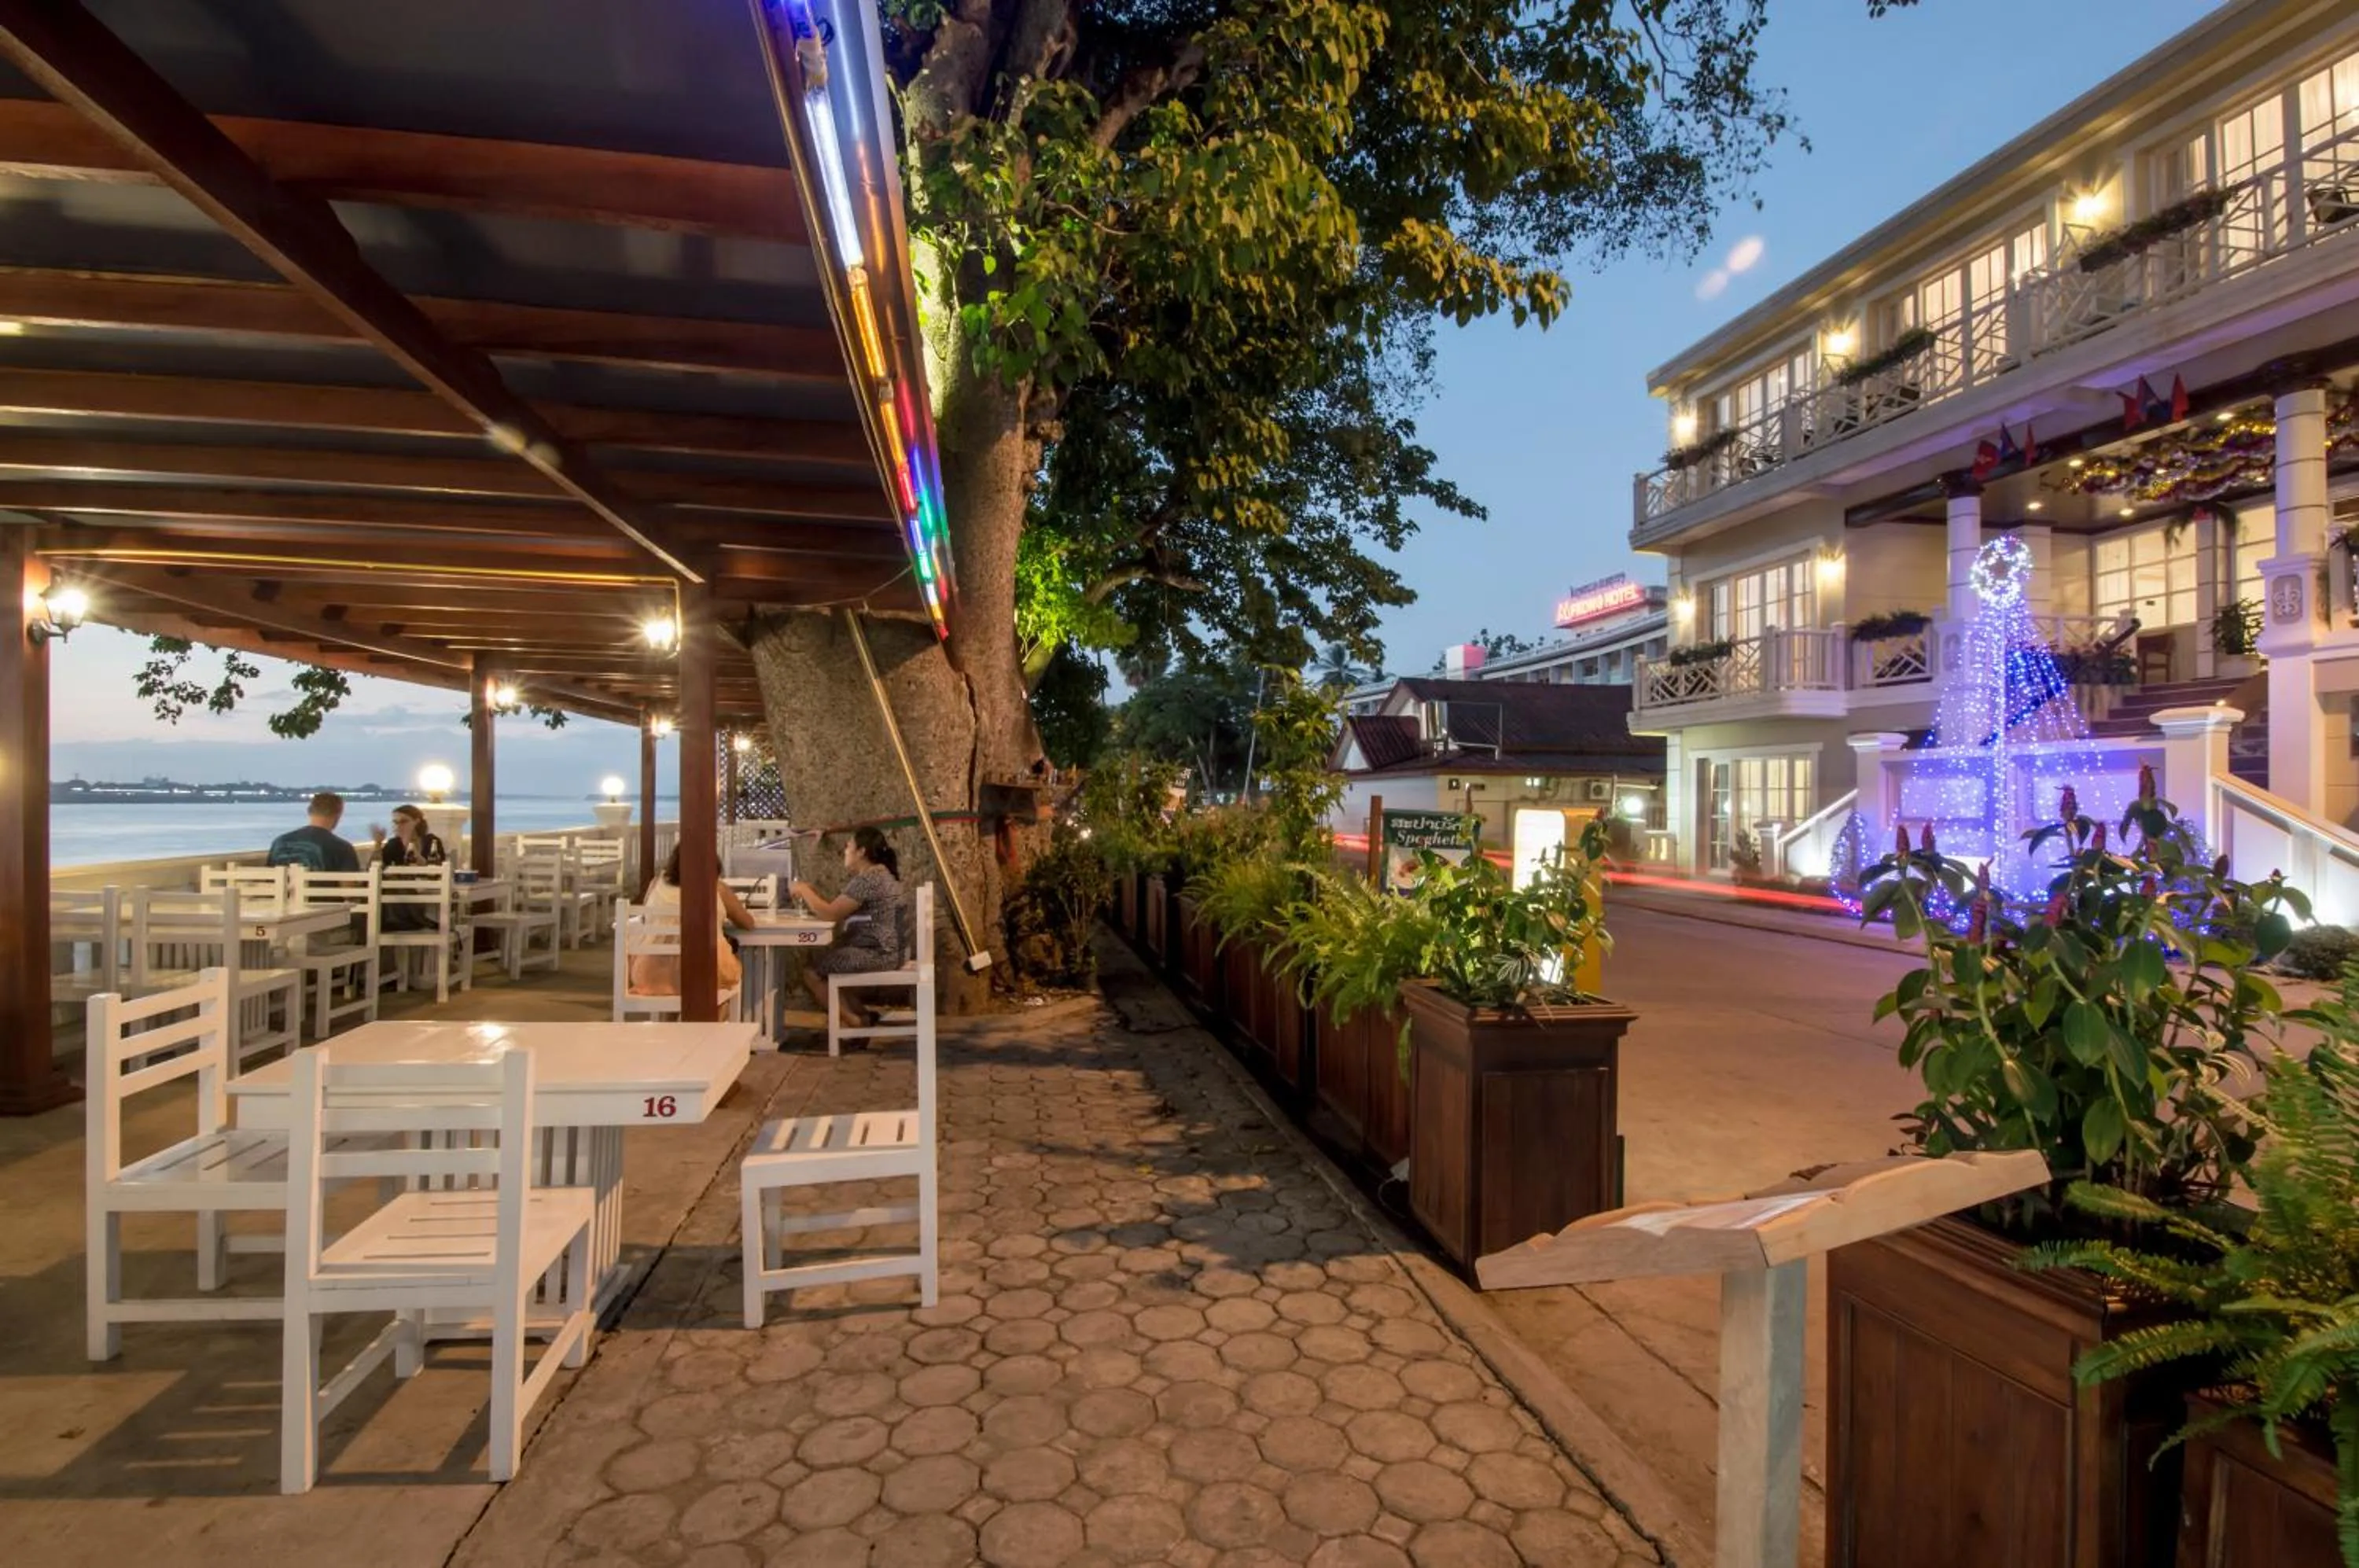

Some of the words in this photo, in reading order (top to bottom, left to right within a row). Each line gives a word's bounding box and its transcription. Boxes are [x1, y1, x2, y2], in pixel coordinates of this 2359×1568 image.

[1602, 582, 1640, 606] HOTEL
[256, 926, 265, 937] 5
[798, 931, 818, 943] 20
[642, 1095, 677, 1117] 16
